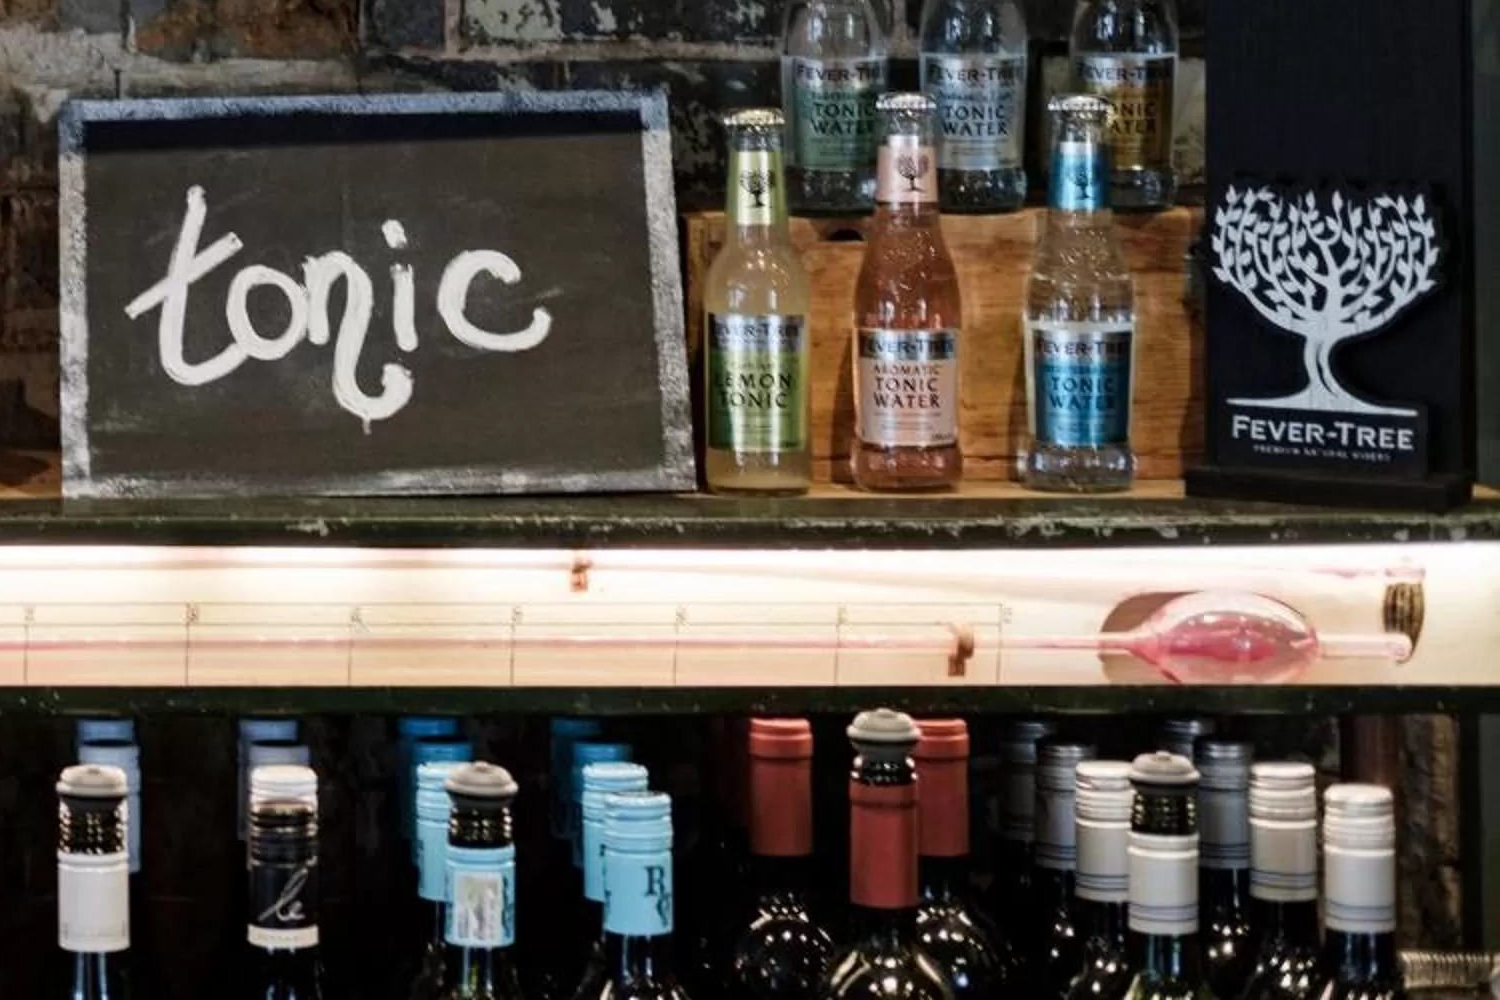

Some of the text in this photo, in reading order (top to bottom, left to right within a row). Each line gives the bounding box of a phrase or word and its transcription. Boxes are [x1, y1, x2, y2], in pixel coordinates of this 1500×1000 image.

[943, 104, 1006, 120] TONIC
[1111, 103, 1156, 118] ONIC
[942, 121, 1008, 137] WATER
[1111, 119, 1157, 135] ATER
[123, 184, 555, 428] tonic
[712, 372, 792, 389] LEMON
[875, 376, 938, 393] TONIC
[1051, 376, 1113, 393] TONIC
[720, 391, 789, 409] TONIC
[873, 392, 941, 408] WATER
[1231, 413, 1416, 451] FEVER-TREE
